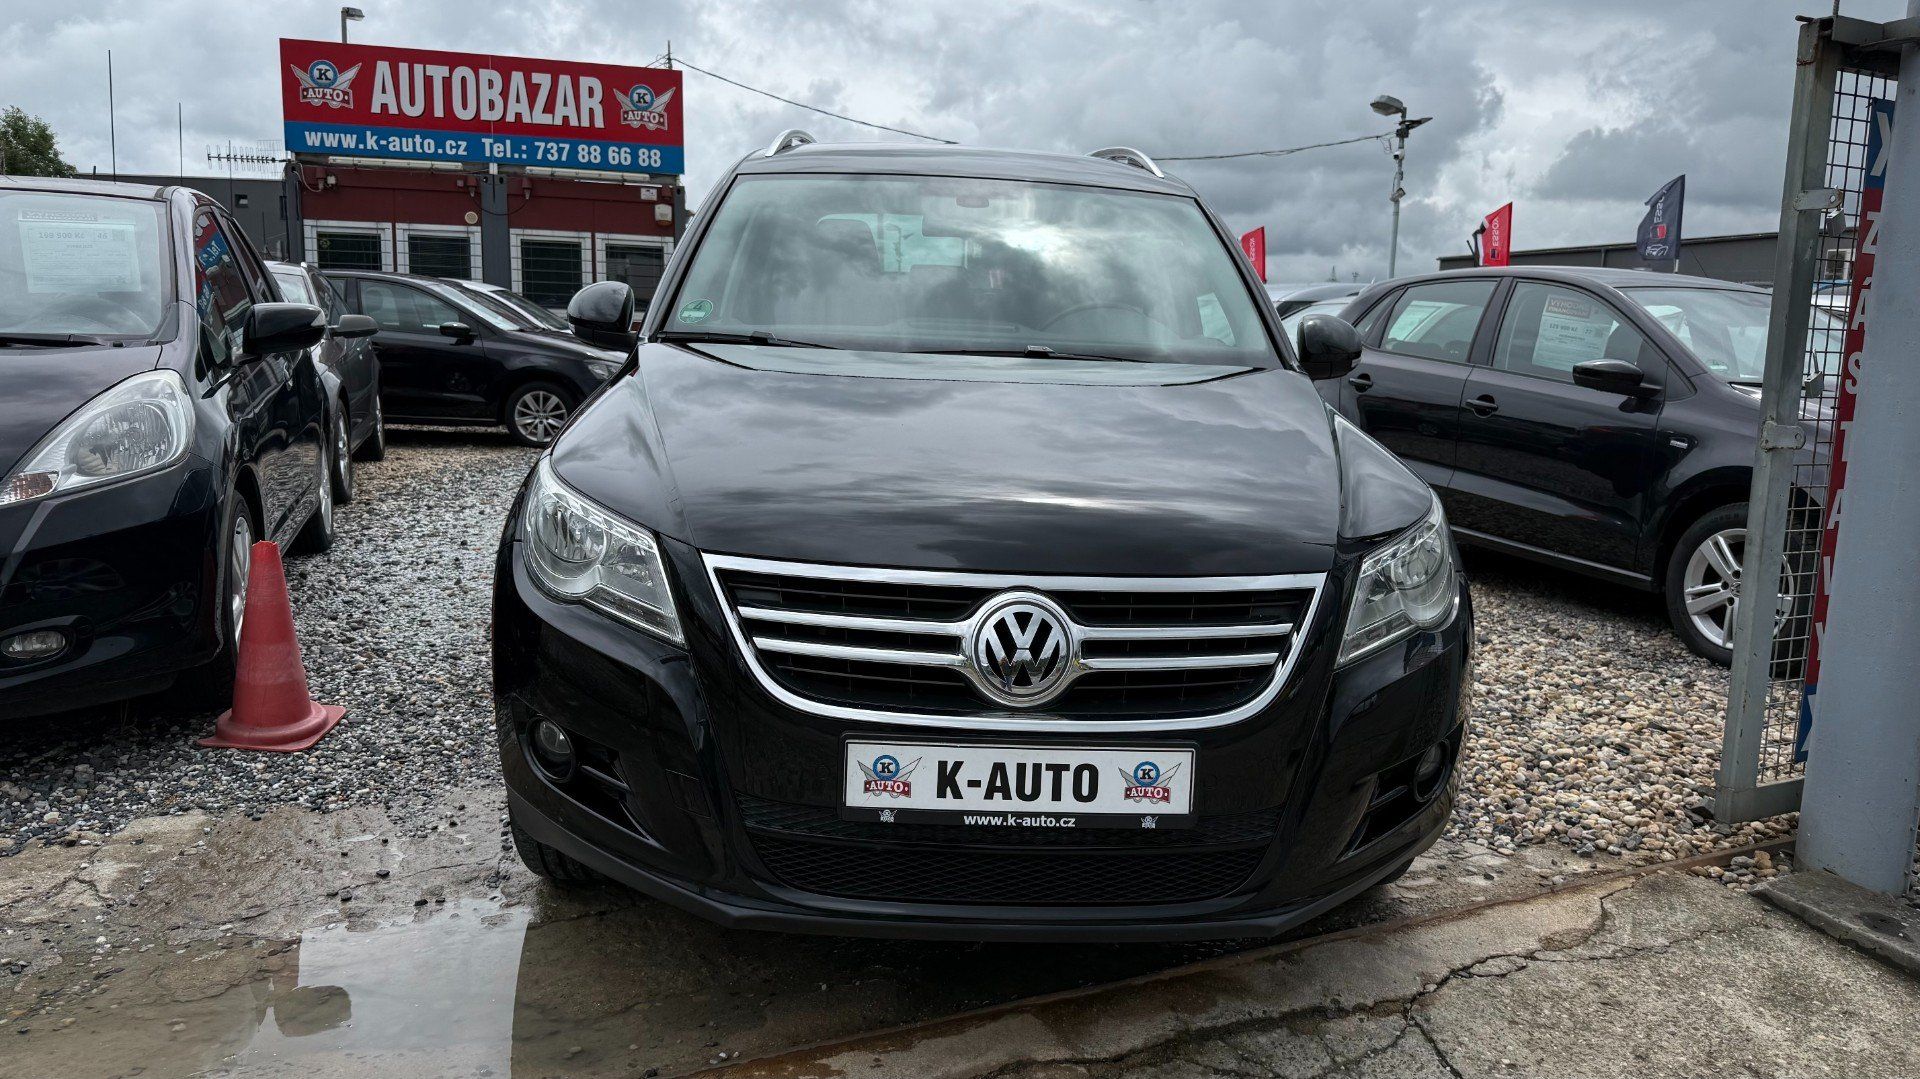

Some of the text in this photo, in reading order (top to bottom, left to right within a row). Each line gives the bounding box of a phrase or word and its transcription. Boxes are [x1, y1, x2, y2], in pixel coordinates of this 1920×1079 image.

[315, 67, 332, 81] K
[306, 88, 344, 102] AUTO
[371, 60, 605, 129] AUTOBAZAR
[635, 92, 649, 104] K
[627, 110, 660, 124] AUTO
[304, 130, 662, 168] www.k-auto.cz Tel.: 737 88 66 88
[879, 761, 894, 775] K
[1140, 768, 1155, 780] K
[868, 780, 905, 794] AUTO
[936, 760, 1099, 803] K-AUTO
[1129, 786, 1164, 799] AUTO
[963, 814, 1076, 829] www.k-auto.cz
